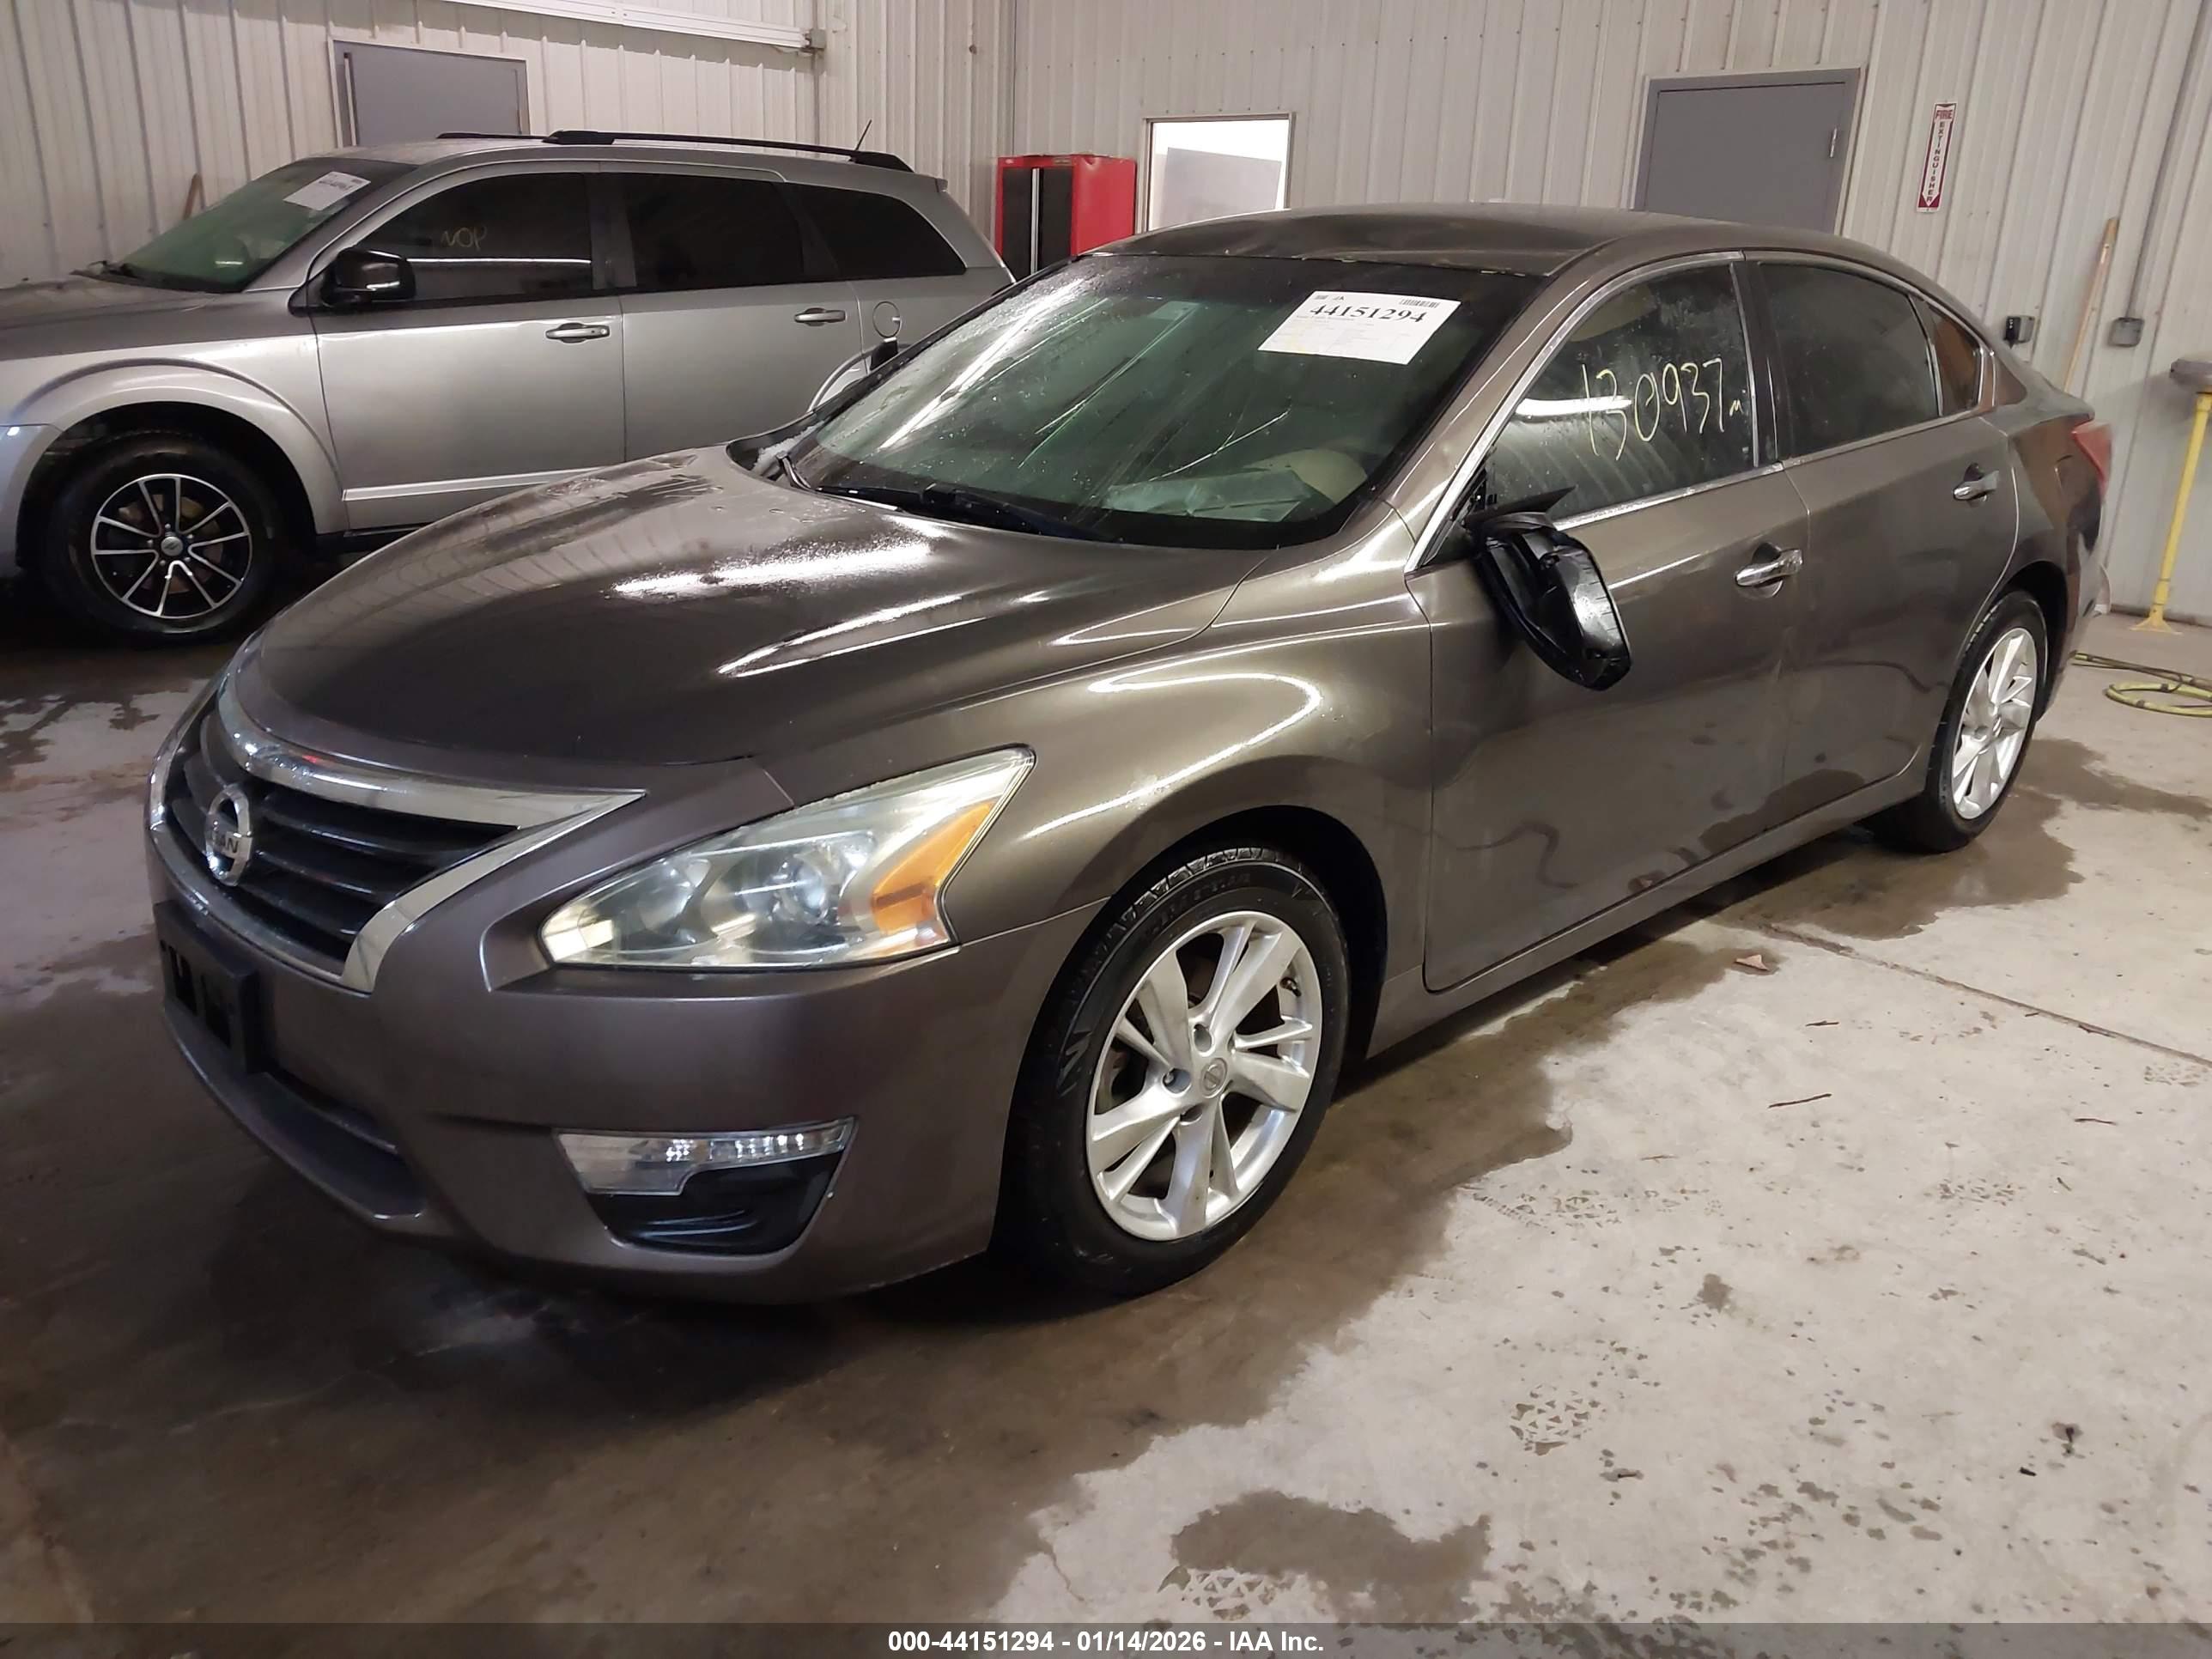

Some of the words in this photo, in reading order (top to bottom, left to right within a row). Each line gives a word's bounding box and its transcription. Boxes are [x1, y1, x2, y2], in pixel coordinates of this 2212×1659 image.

[1935, 109, 1953, 119] FIRE
[1926, 121, 1946, 202] EXTINGUISHER
[1310, 303, 1428, 323] 44151294
